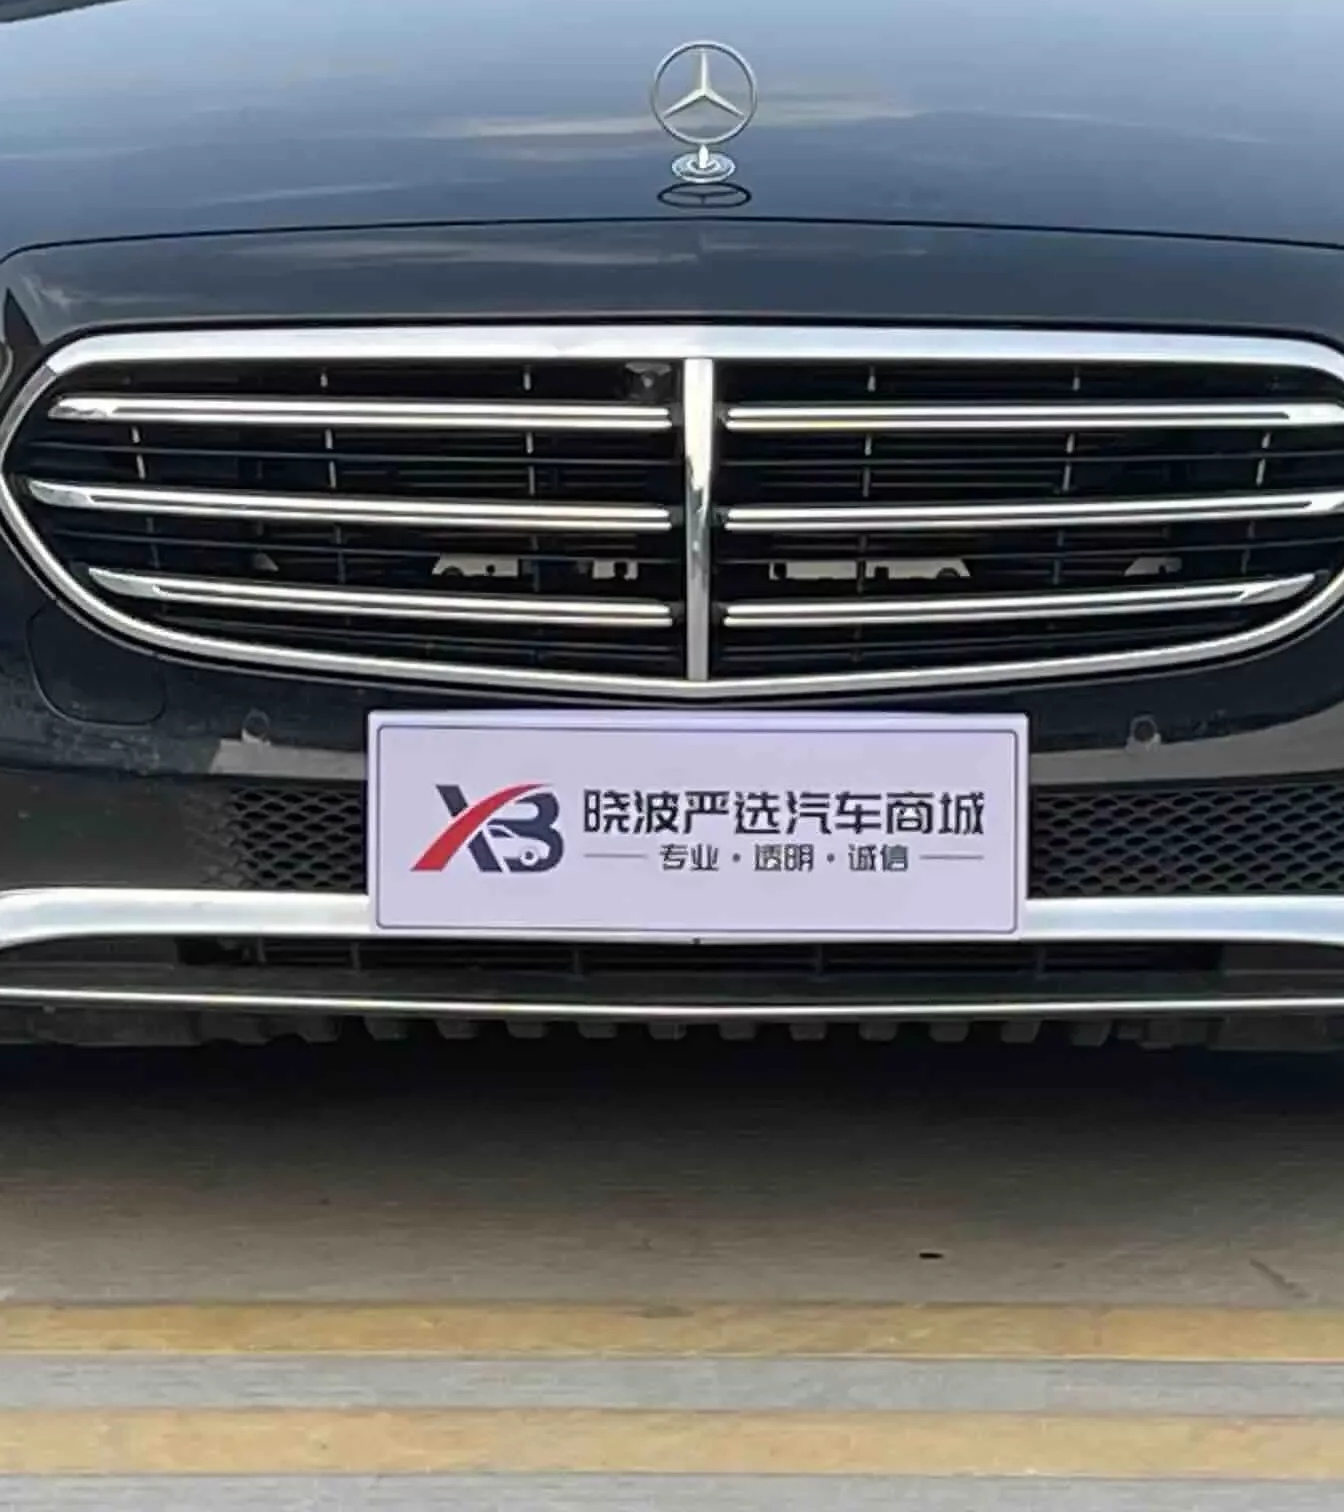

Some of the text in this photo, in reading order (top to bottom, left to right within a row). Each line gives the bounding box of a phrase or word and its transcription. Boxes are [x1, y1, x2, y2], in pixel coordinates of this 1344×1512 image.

[582, 790, 985, 836] 晓波严选汽车商城
